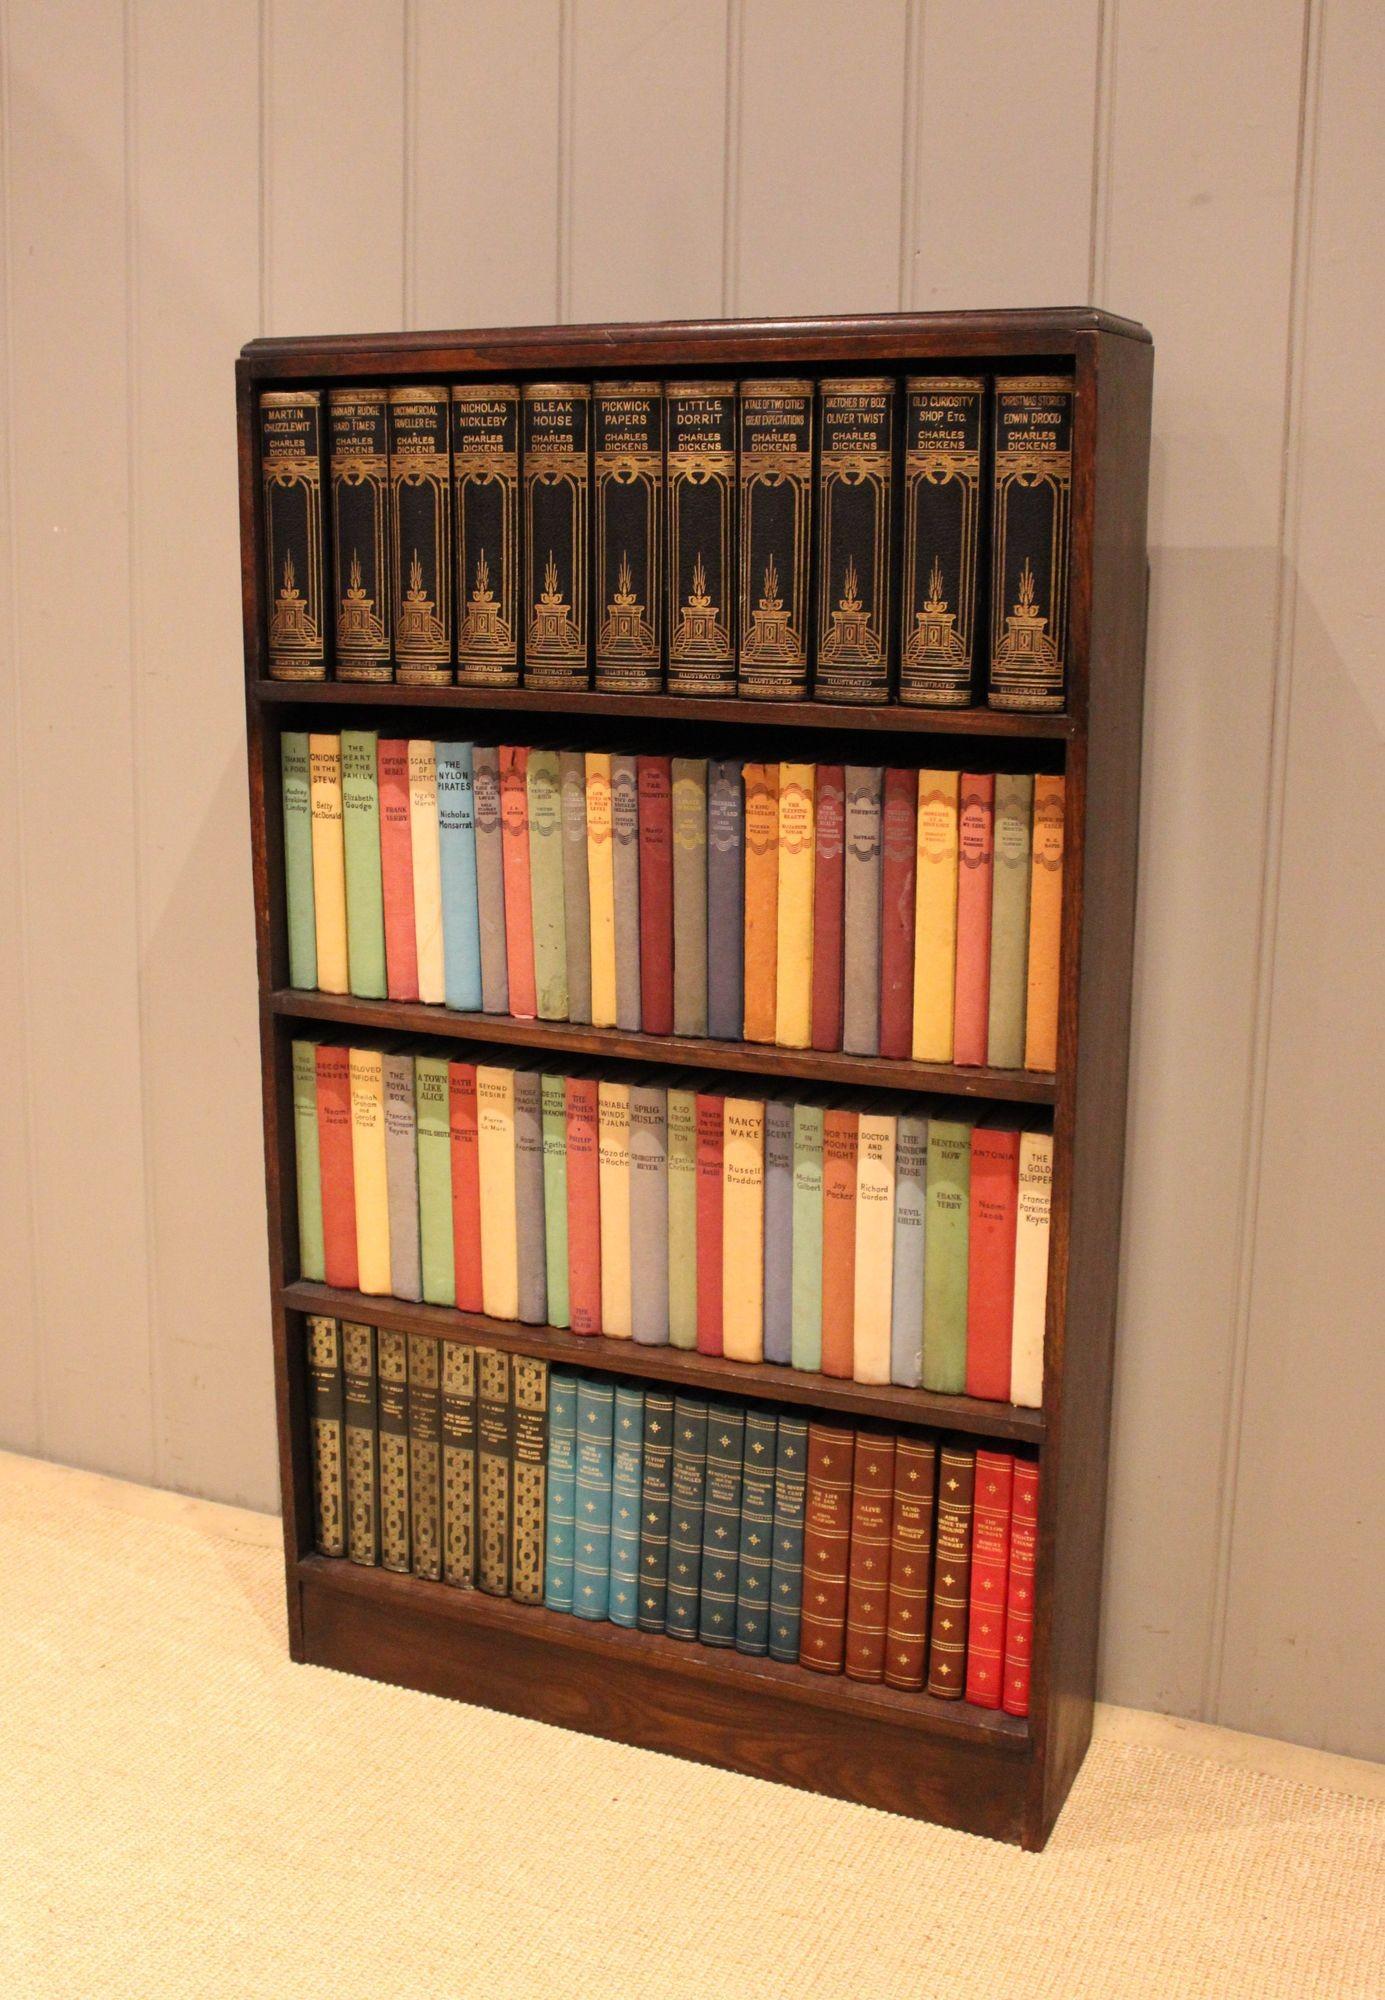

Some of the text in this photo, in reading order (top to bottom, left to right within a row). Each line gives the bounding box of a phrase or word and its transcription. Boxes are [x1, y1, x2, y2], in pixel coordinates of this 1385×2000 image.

[601, 401, 650, 412] PICKWICK
[678, 400, 722, 411] LITTLE
[770, 399, 784, 410] TWO
[859, 397, 869, 408] BY
[870, 397, 887, 408] BOZ
[930, 396, 974, 407] CURIOSITY
[358, 405, 380, 416] RUDGE
[461, 403, 507, 413] NICHOLAS
[533, 402, 574, 413] BLEAK
[268, 409, 304, 420] MARTIN
[605, 414, 647, 425] PAPERS
[677, 413, 723, 425] DORRIT
[826, 412, 885, 424] OLIVER TWIST
[919, 410, 944, 422] SHOP
[1003, 413, 1029, 425] EDWIN
[352, 420, 376, 431] TIMES
[460, 417, 508, 427] NICKLEBY
[533, 415, 573, 427] HOUSE
[463, 435, 504, 443] CHARLES
[531, 434, 573, 443] CHARLES
[604, 432, 648, 441] CHARLES
[678, 433, 721, 442] CHARLES
[751, 433, 798, 442] CHARLES
[832, 431, 877, 441] CHARLES
[918, 430, 965, 439] CHARLES
[1007, 431, 1056, 440] CHARLES
[269, 439, 305, 448] CHARLES
[336, 437, 373, 446] CHARLES
[397, 436, 434, 445] CHARLES
[832, 441, 878, 450] DICKENS
[918, 440, 965, 450] DICKENS
[336, 446, 374, 454] DICKENS
[397, 446, 436, 454] DICKENS
[463, 444, 504, 453] DICKENS
[531, 443, 574, 453] DICKENS
[604, 442, 649, 451] DICKENS
[678, 442, 722, 451] DICKENS
[752, 443, 798, 452] DICKENS
[1007, 441, 1057, 451] DICKENS
[270, 448, 306, 456] DICKENS
[348, 743, 364, 752] THE
[309, 753, 341, 763] ONIONS
[445, 760, 461, 770] THE
[312, 775, 337, 785] STEW
[438, 771, 468, 781] NYLON
[440, 807, 471, 819] Nicholas
[439, 817, 473, 830] Monsarrat
[389, 1071, 406, 1081] THE
[417, 1073, 449, 1084] A TOWN
[423, 1083, 442, 1093] LIKE
[479, 1082, 508, 1092] BEYOND
[389, 1093, 406, 1102] BOX
[420, 1092, 446, 1102] ALICE
[479, 1091, 507, 1099] DESIRE
[633, 1103, 661, 1115] SPRIG
[600, 1111, 627, 1120] WINDS
[631, 1113, 666, 1126] MUSLIN
[606, 1119, 631, 1129] JALNA
[729, 1114, 762, 1128] NANCY
[674, 1133, 688, 1143] TON
[730, 1127, 760, 1140] WAKE
[861, 1132, 890, 1142] DOCTOR
[903, 1135, 921, 1145] THE
[868, 1143, 882, 1151] AND
[867, 1152, 882, 1161] SON
[1032, 1153, 1049, 1163] THE
[728, 1163, 762, 1176] Russell
[900, 1166, 921, 1177] ROSE
[1027, 1163, 1053, 1174] GOLD
[727, 1174, 763, 1186] Braddon
[860, 1183, 889, 1194] Richard
[861, 1192, 889, 1201] Gordon
[1026, 1214, 1050, 1228] Keyes
